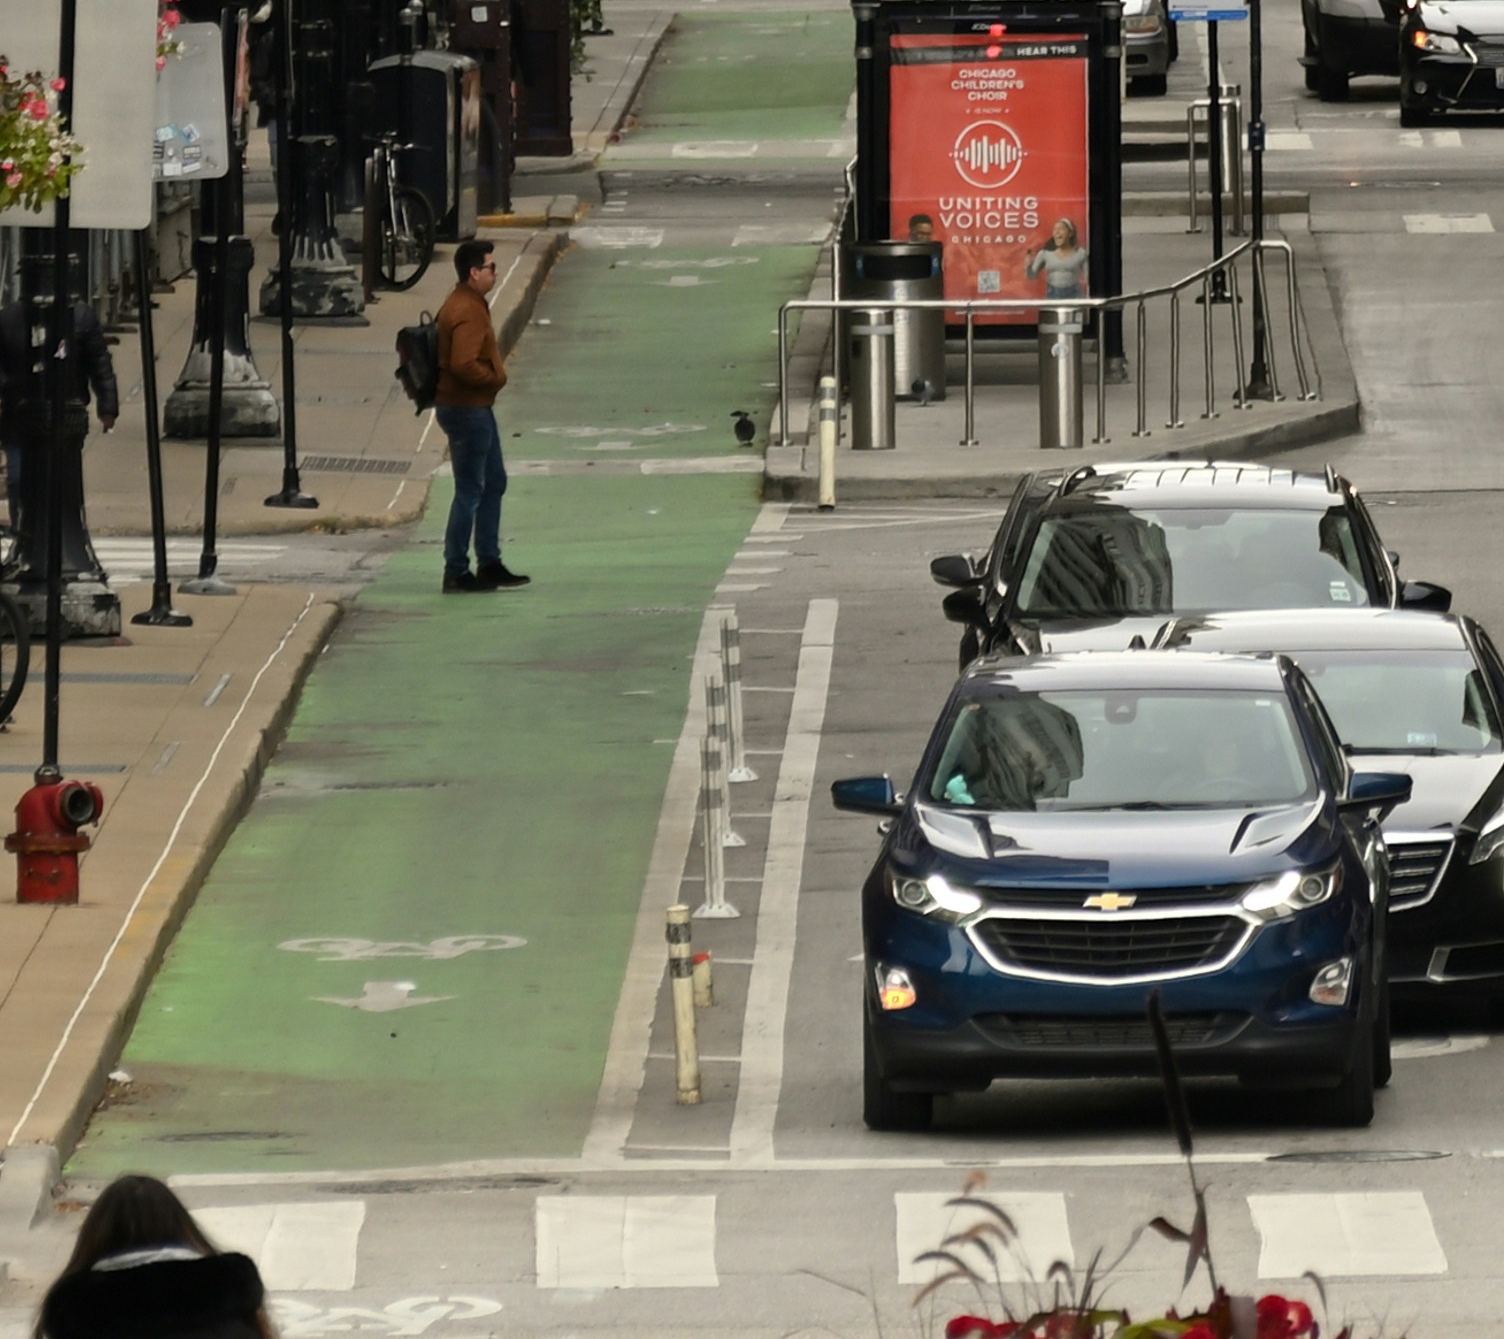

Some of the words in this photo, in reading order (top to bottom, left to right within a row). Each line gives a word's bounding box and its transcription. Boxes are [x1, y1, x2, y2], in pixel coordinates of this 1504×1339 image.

[1016, 46, 1048, 57] HEAR
[1050, 45, 1077, 56] THIS
[958, 68, 1017, 79] CHICAGO
[967, 91, 1008, 101] CHOIR
[938, 196, 1039, 211] UNITING
[938, 211, 1040, 229] VOICES
[951, 234, 1027, 244] CHICAGO
